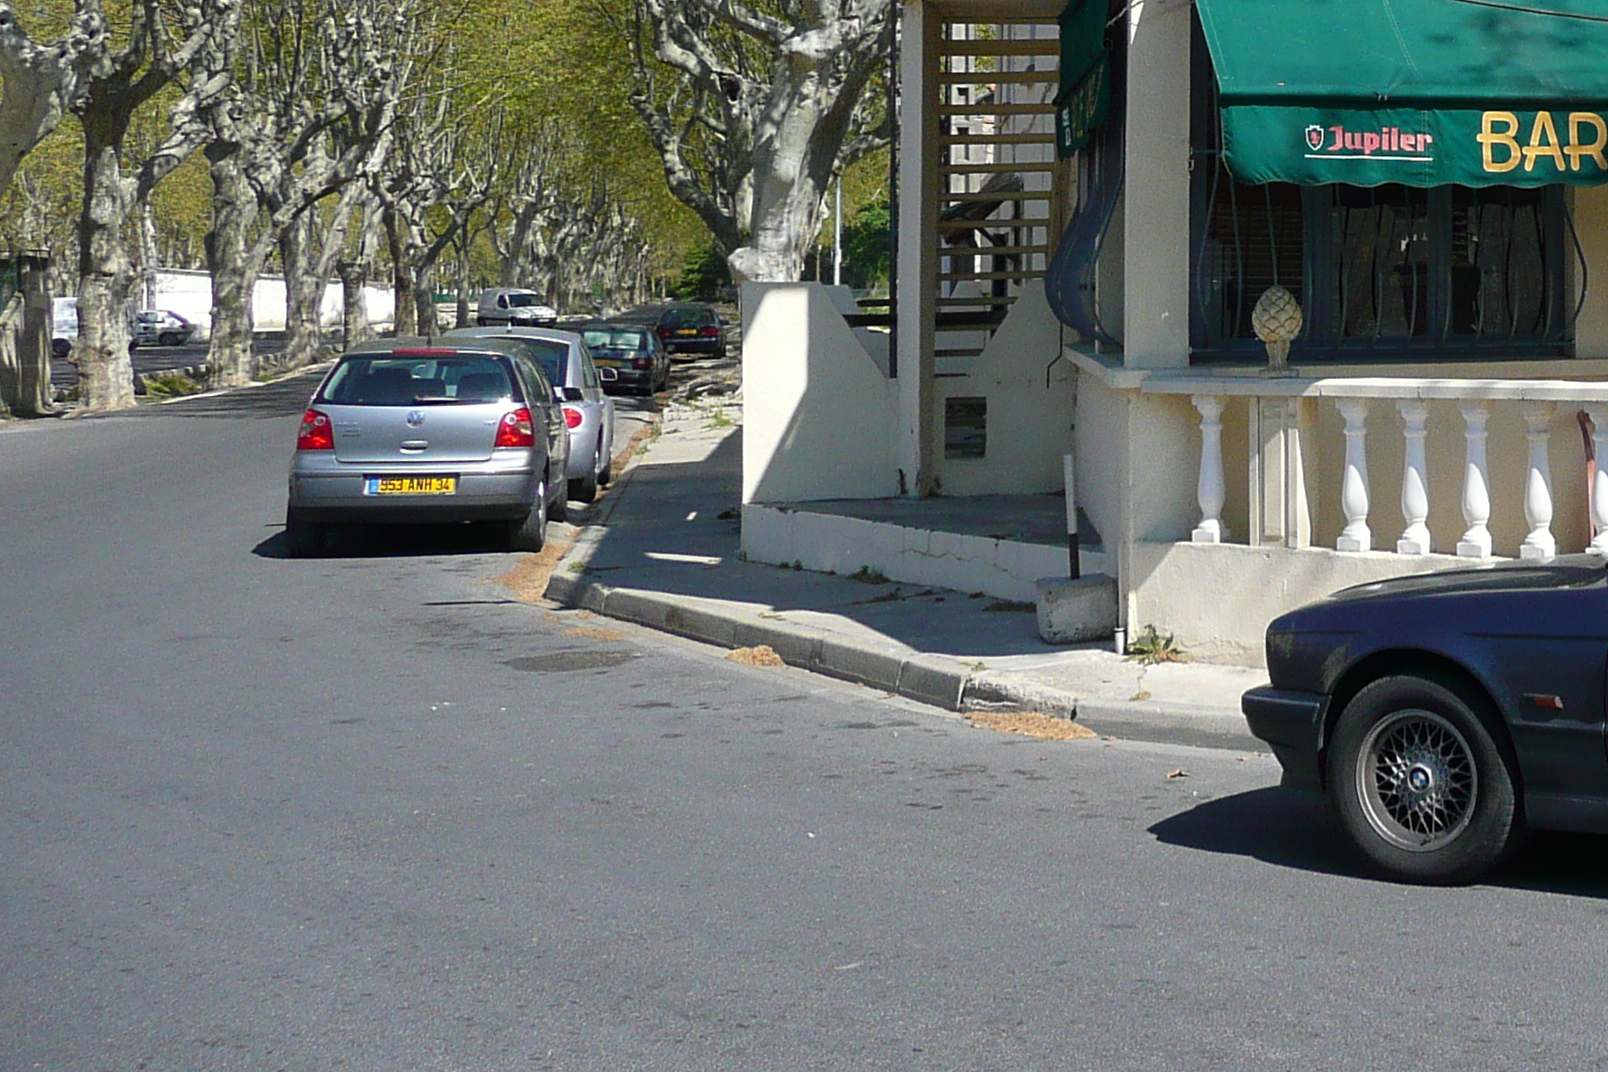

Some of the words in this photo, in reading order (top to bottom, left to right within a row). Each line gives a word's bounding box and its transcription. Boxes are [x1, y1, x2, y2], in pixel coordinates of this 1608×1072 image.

[1327, 126, 1433, 154] Jupiler
[1476, 110, 1608, 172] BAR
[408, 479, 432, 491] ANH
[435, 479, 450, 491] 34
